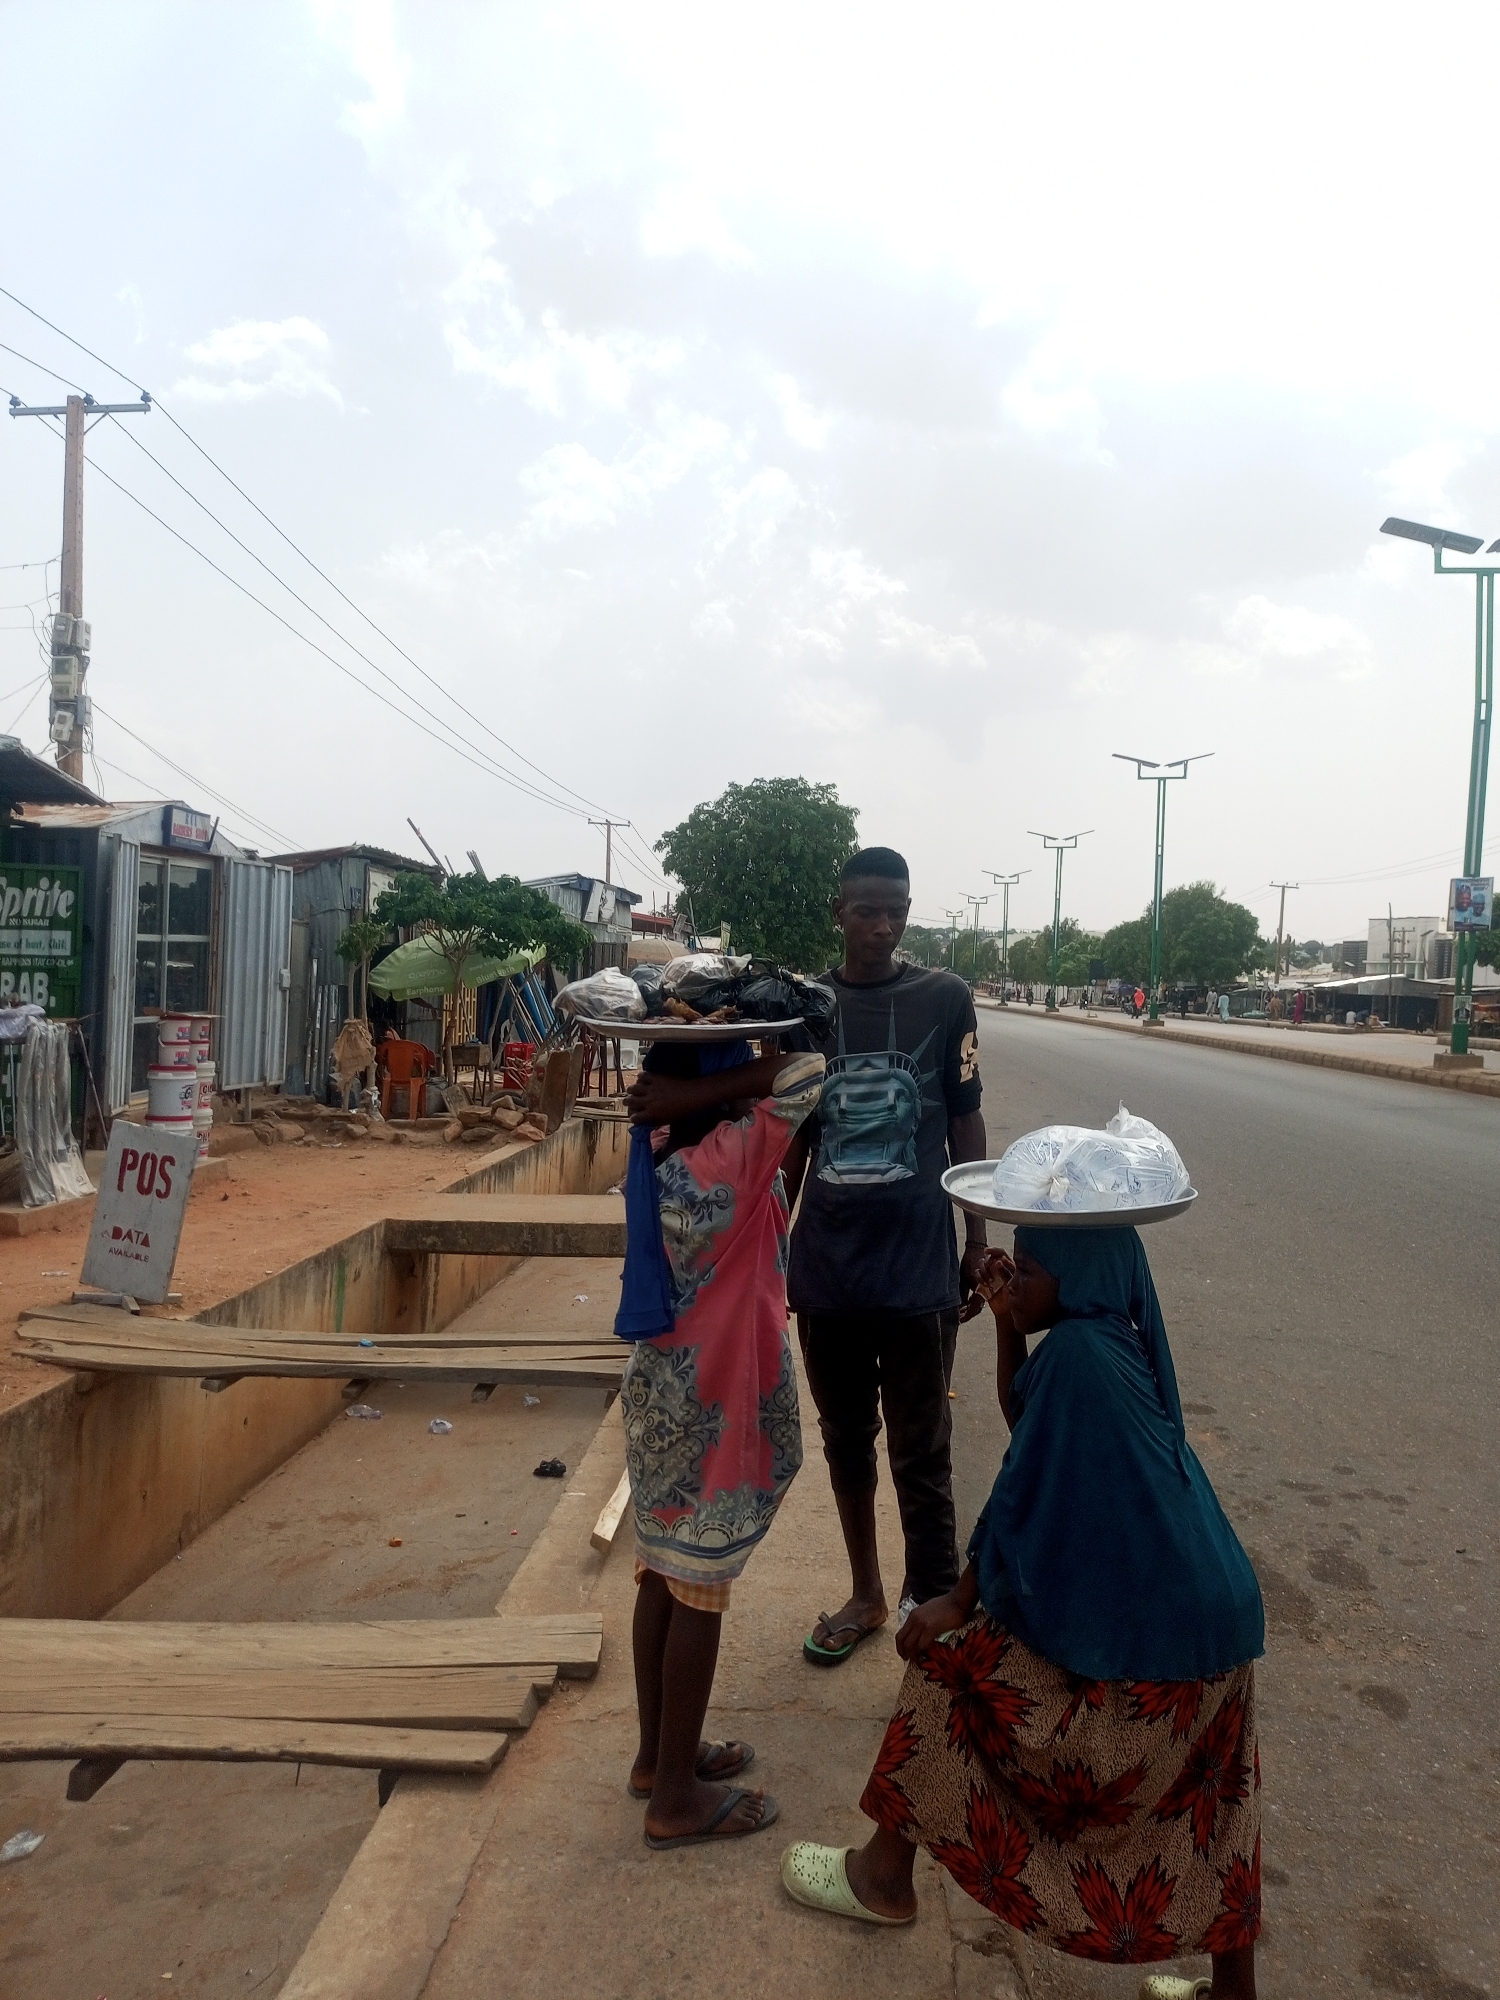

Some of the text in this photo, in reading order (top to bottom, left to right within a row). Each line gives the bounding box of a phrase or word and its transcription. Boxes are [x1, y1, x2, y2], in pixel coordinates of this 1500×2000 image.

[475, 965, 516, 984] Bluetooth
[117, 1148, 176, 1199] POS
[111, 1225, 151, 1248] DATA
[108, 1246, 150, 1263] AVAILABLE
